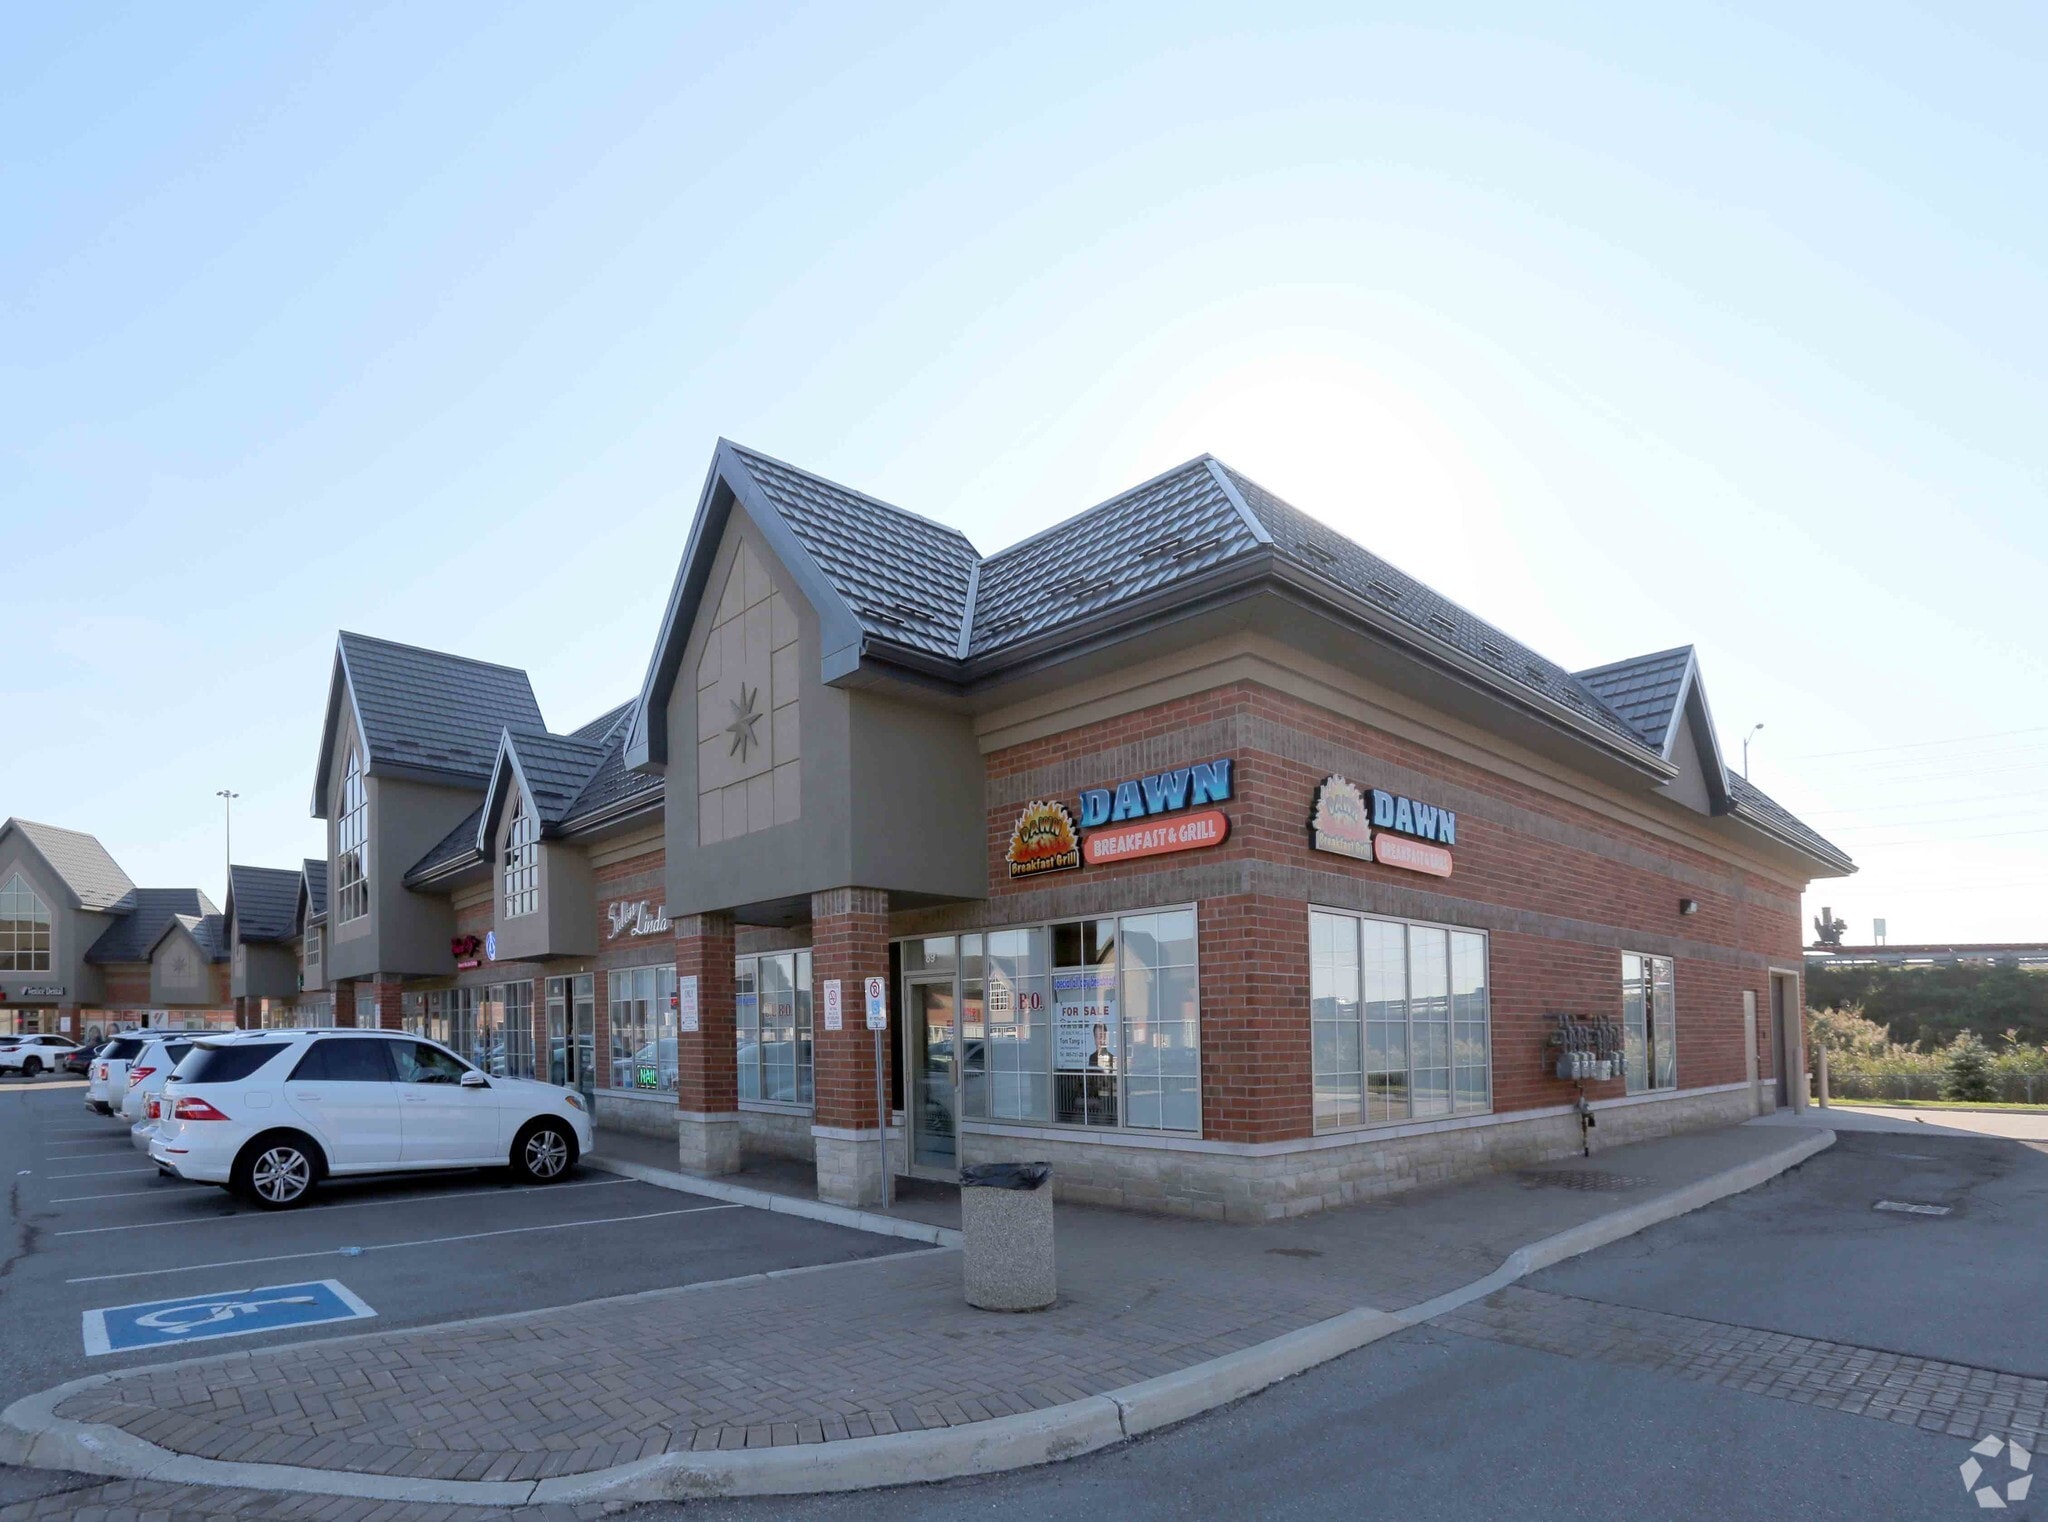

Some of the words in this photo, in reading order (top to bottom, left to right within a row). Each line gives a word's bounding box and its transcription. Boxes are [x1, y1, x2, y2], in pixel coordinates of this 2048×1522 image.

[1080, 758, 1232, 828] DAWN
[1020, 815, 1062, 843] DAWN
[1373, 789, 1456, 845] DAWN
[1094, 828, 1167, 857] BREAKFAST
[1168, 828, 1177, 844] &
[1179, 819, 1217, 845] GRILL
[1011, 857, 1055, 875] Breakfast
[1056, 853, 1076, 868] Grill
[607, 902, 638, 939] Salon
[631, 900, 669, 936] Linda
[1062, 1007, 1079, 1016] FOR
[1083, 1005, 1110, 1016] SALE
